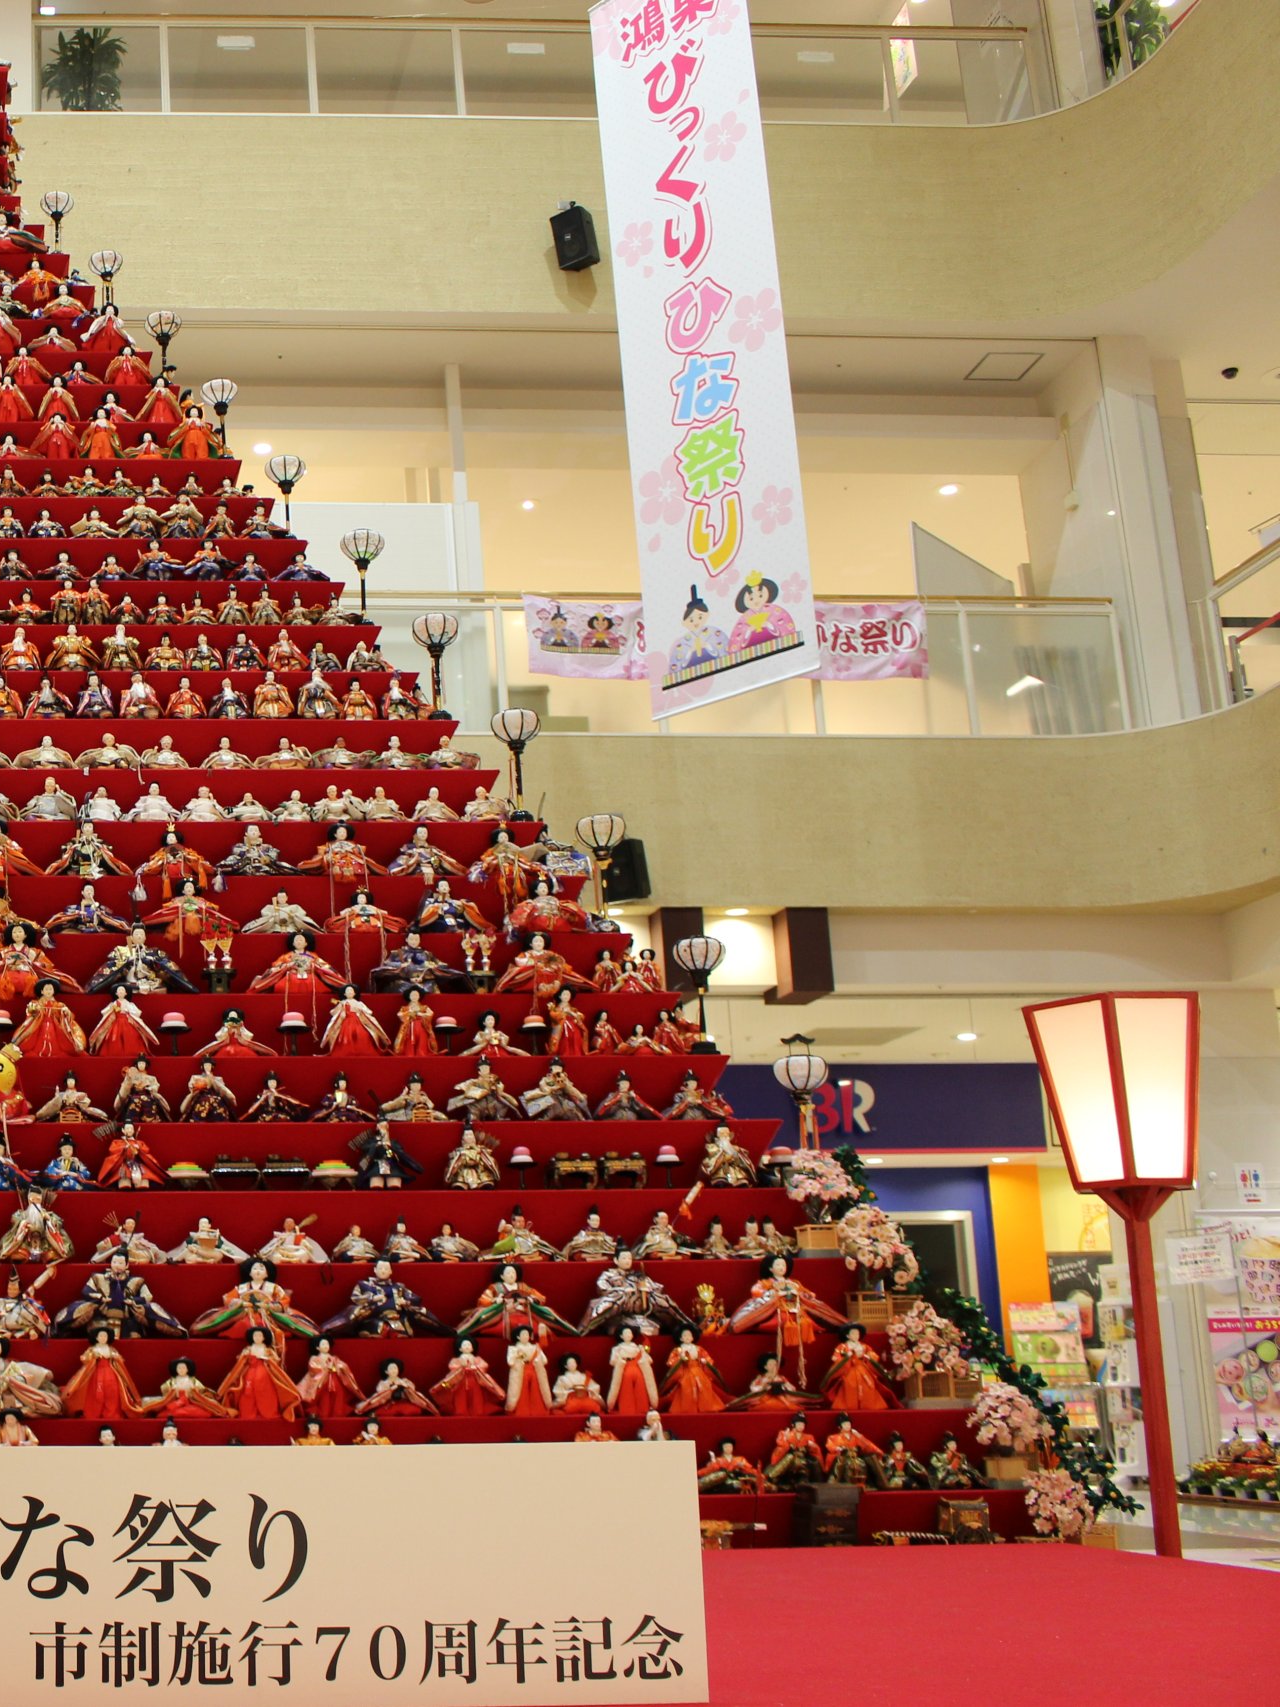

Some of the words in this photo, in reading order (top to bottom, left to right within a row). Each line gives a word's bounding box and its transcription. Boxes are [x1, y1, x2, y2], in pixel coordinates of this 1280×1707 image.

[29, 1614, 685, 1688] 市制施行70周年記念
